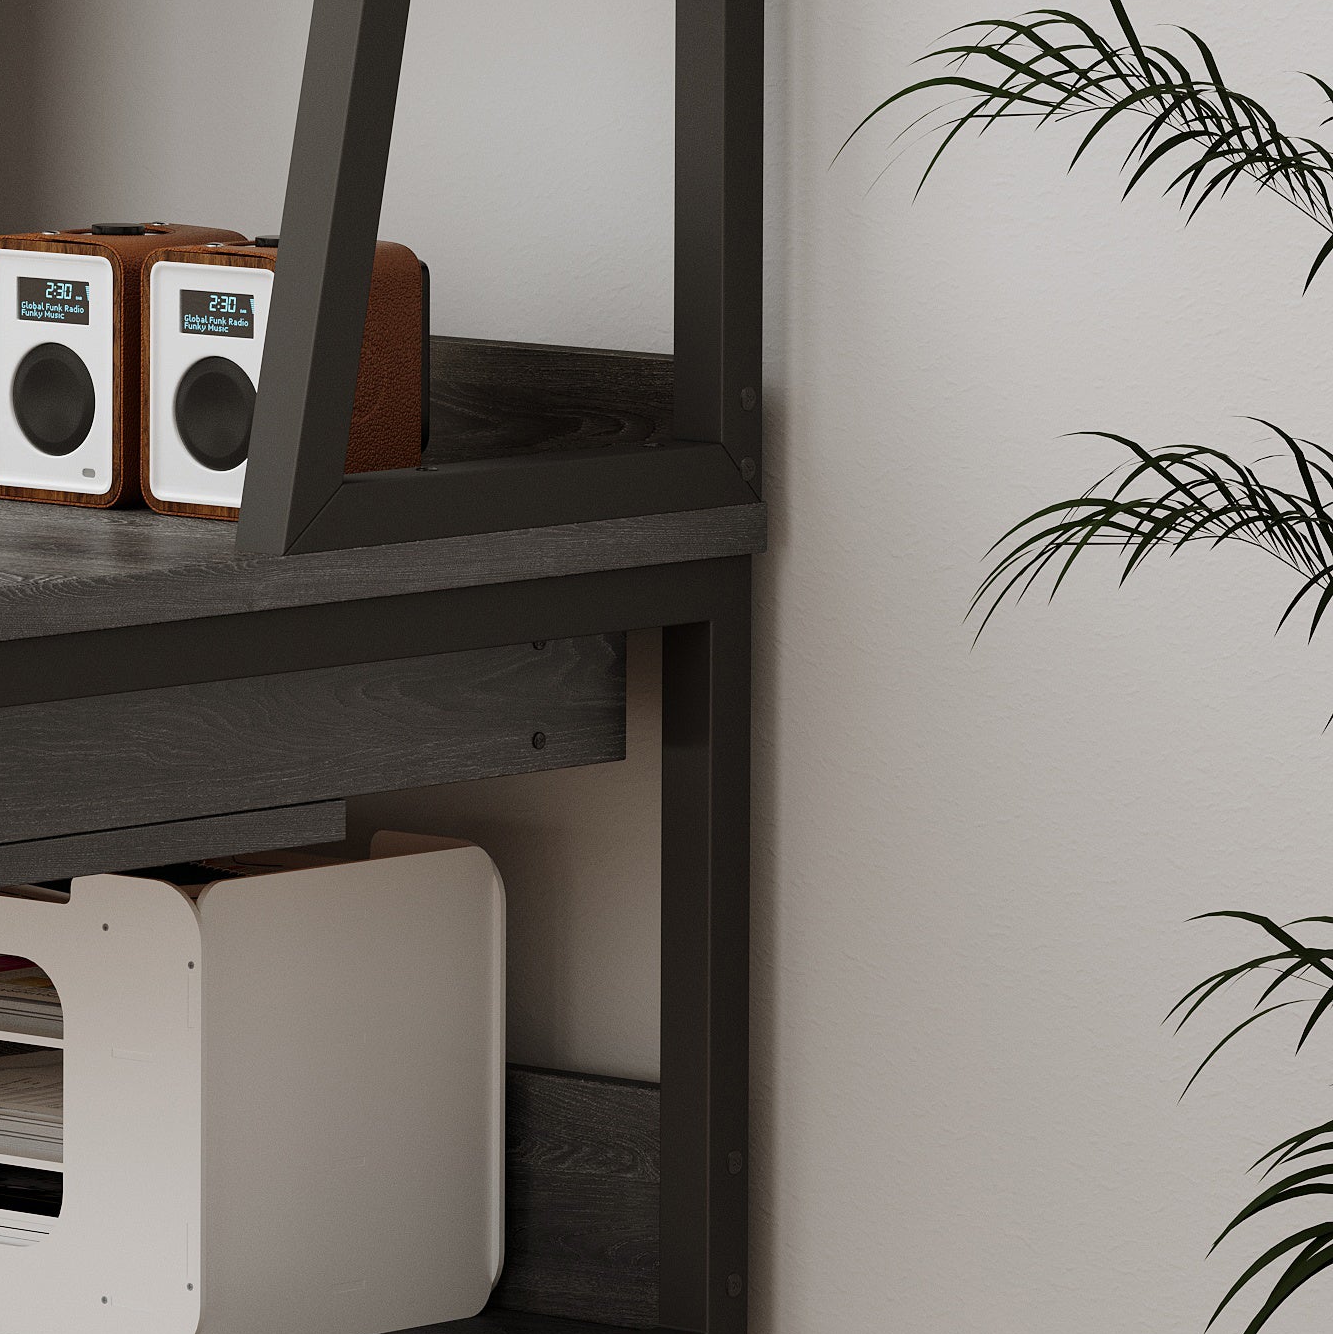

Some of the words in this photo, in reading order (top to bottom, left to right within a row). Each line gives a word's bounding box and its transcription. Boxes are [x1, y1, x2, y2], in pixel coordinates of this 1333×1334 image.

[45, 282, 73, 300] 2:30
[21, 300, 45, 311] Global
[45, 303, 63, 313] Funk
[64, 304, 85, 314] Radio
[209, 295, 237, 313] 2:30
[21, 309, 43, 319] Funky
[44, 311, 65, 320] Music
[184, 314, 208, 324] Global
[209, 316, 227, 326] Funk
[228, 317, 249, 327] Radio
[184, 322, 207, 333] Funky
[207, 324, 229, 333] Music
